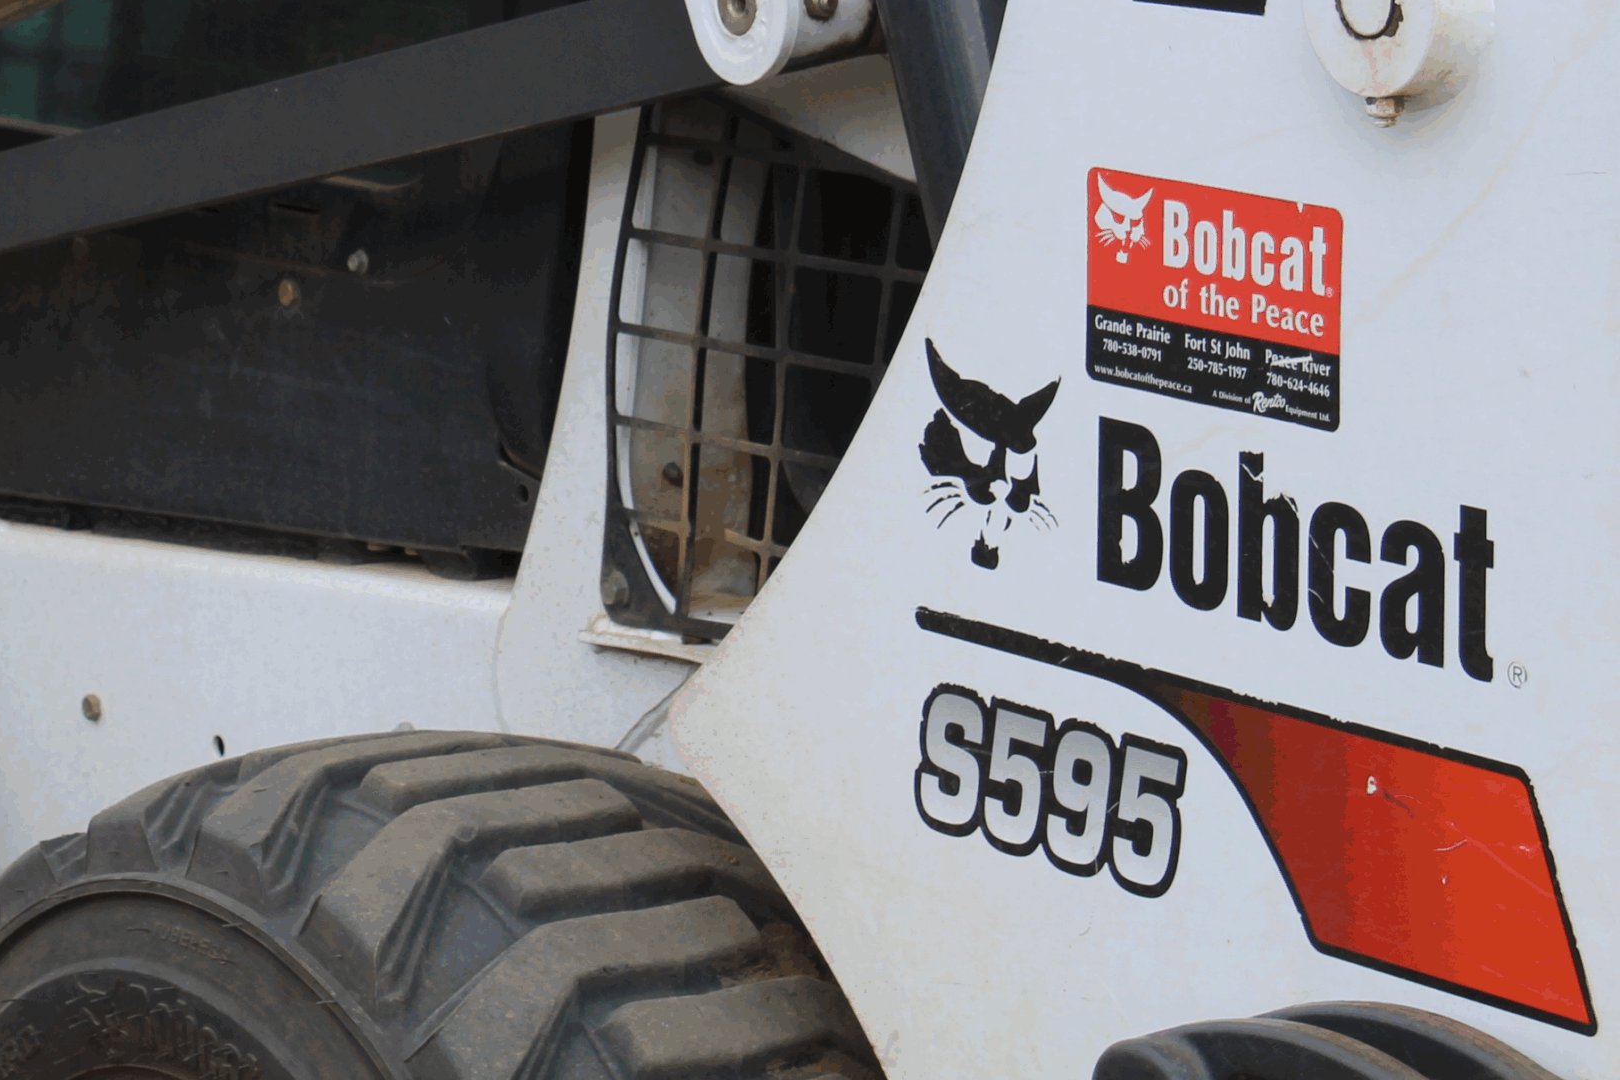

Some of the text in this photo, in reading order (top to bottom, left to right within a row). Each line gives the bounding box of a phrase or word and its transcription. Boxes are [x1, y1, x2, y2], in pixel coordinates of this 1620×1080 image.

[1162, 199, 1327, 297] Bobcat
[1163, 278, 1325, 337] of the Peace
[1094, 314, 1171, 345] Grande Prairie
[1102, 338, 1162, 362] 780-538-0791
[1184, 333, 1251, 362] Fort St John
[1187, 357, 1247, 379] 250-785-1197
[1265, 349, 1331, 377] Peace River
[1094, 364, 1193, 394] www.bobcatofthepeace.ca
[1266, 372, 1331, 398] 780-624-4646
[1218, 391, 1243, 403] Division
[1285, 404, 1318, 420] Equipment
[1095, 415, 1495, 684] Bobcat
[913, 681, 1188, 899] S595
